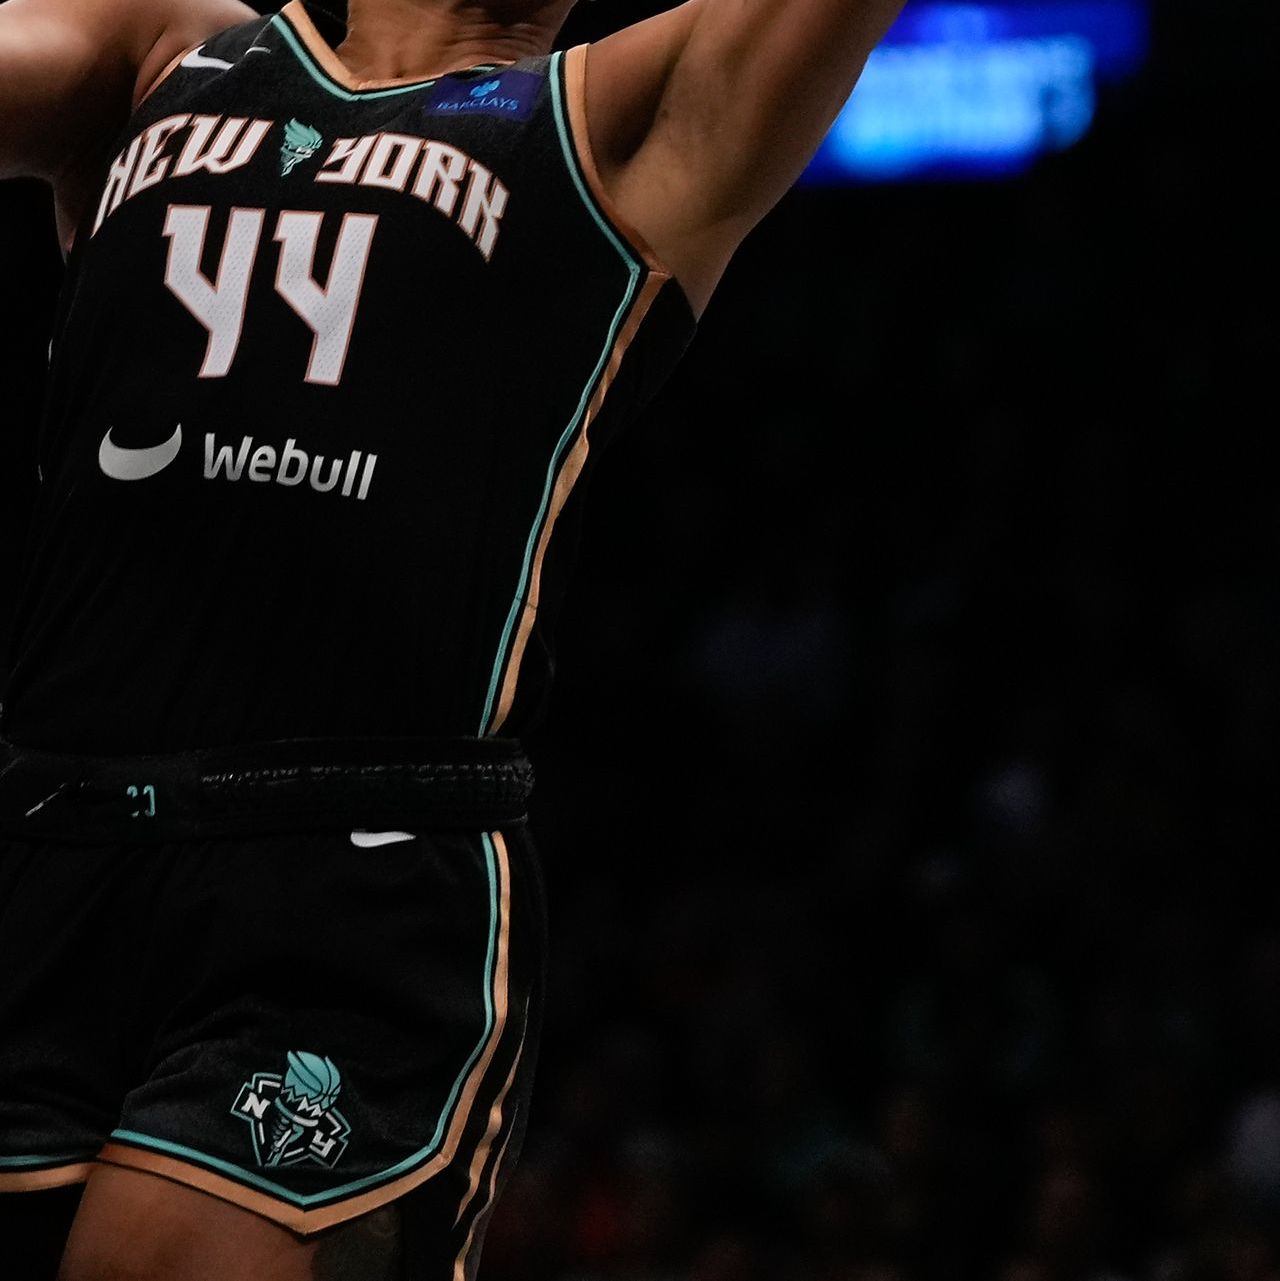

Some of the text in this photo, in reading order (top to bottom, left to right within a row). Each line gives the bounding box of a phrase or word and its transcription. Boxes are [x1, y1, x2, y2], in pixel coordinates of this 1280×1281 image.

[436, 96, 520, 111] BARCLAYS
[91, 113, 510, 265] NEW YORK
[162, 203, 380, 386] 44
[203, 431, 378, 500] Webull
